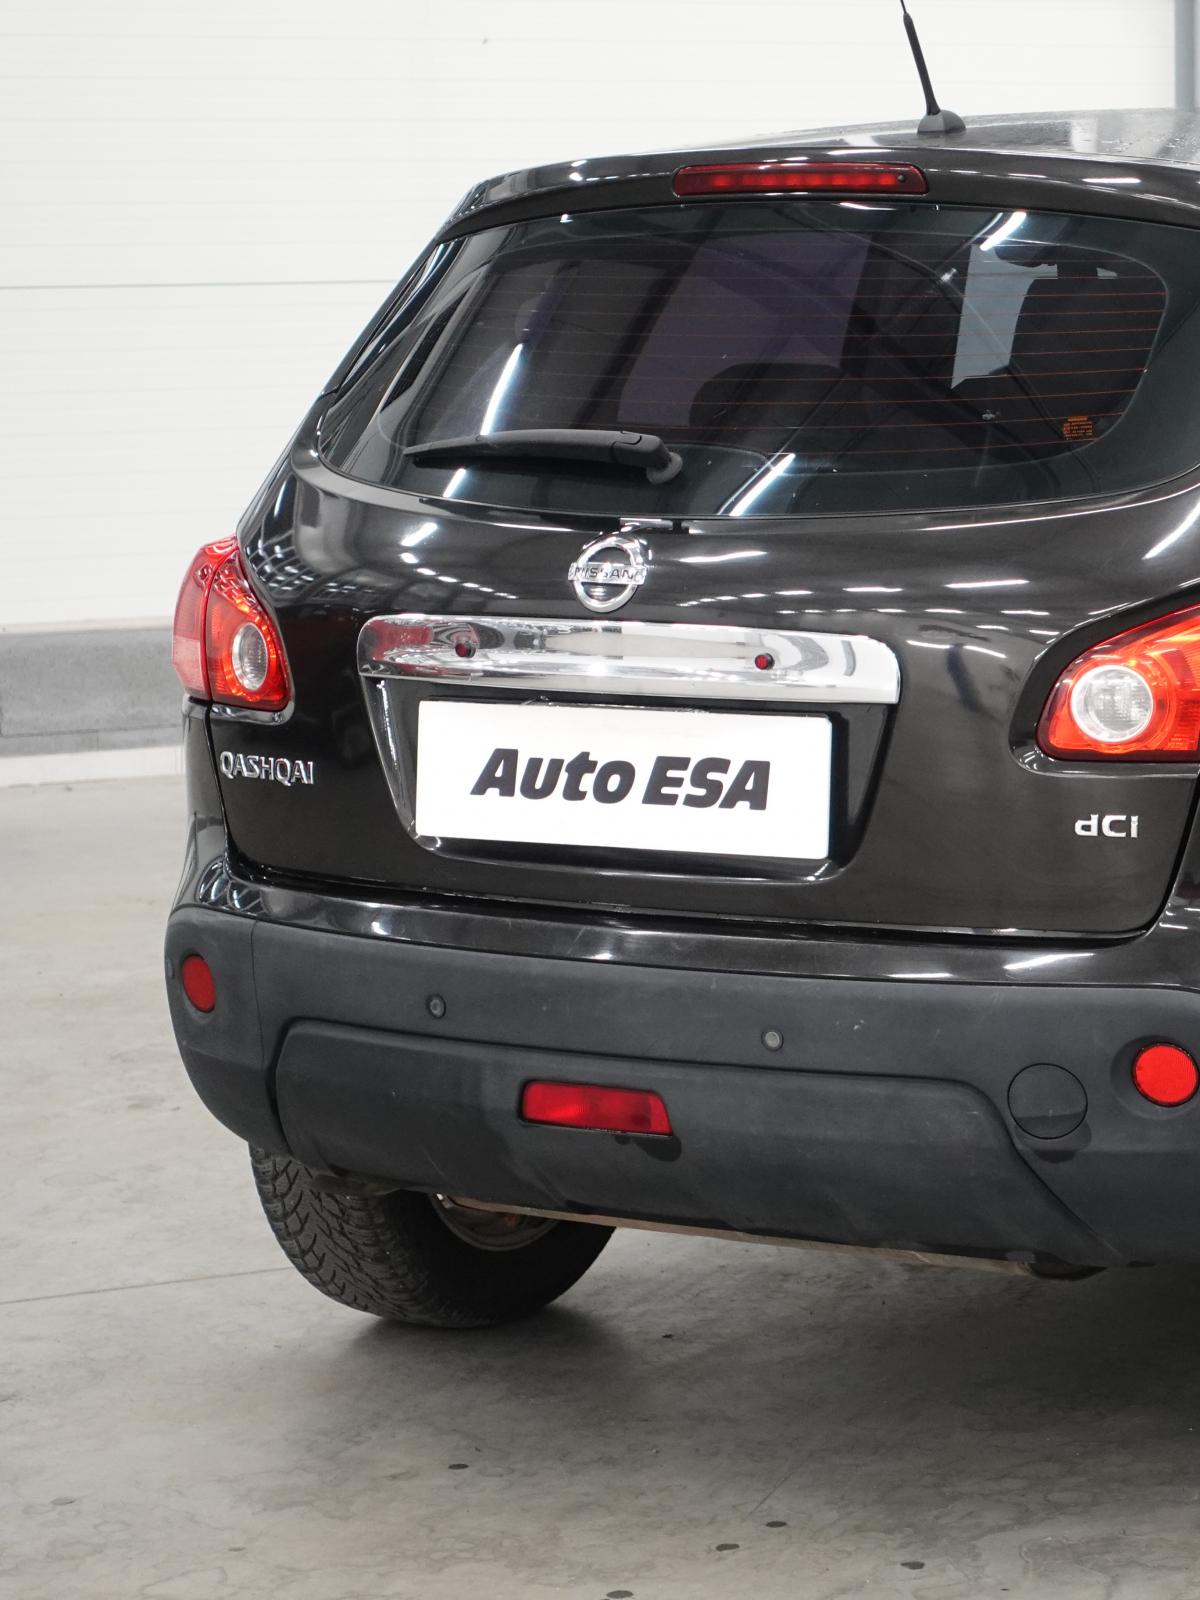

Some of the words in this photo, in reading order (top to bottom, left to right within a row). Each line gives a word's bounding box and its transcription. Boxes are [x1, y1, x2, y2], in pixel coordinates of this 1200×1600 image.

[574, 567, 634, 580] NISSAN
[220, 751, 314, 786] QASHQAI
[470, 748, 635, 804] Auto
[642, 755, 771, 810] ESA
